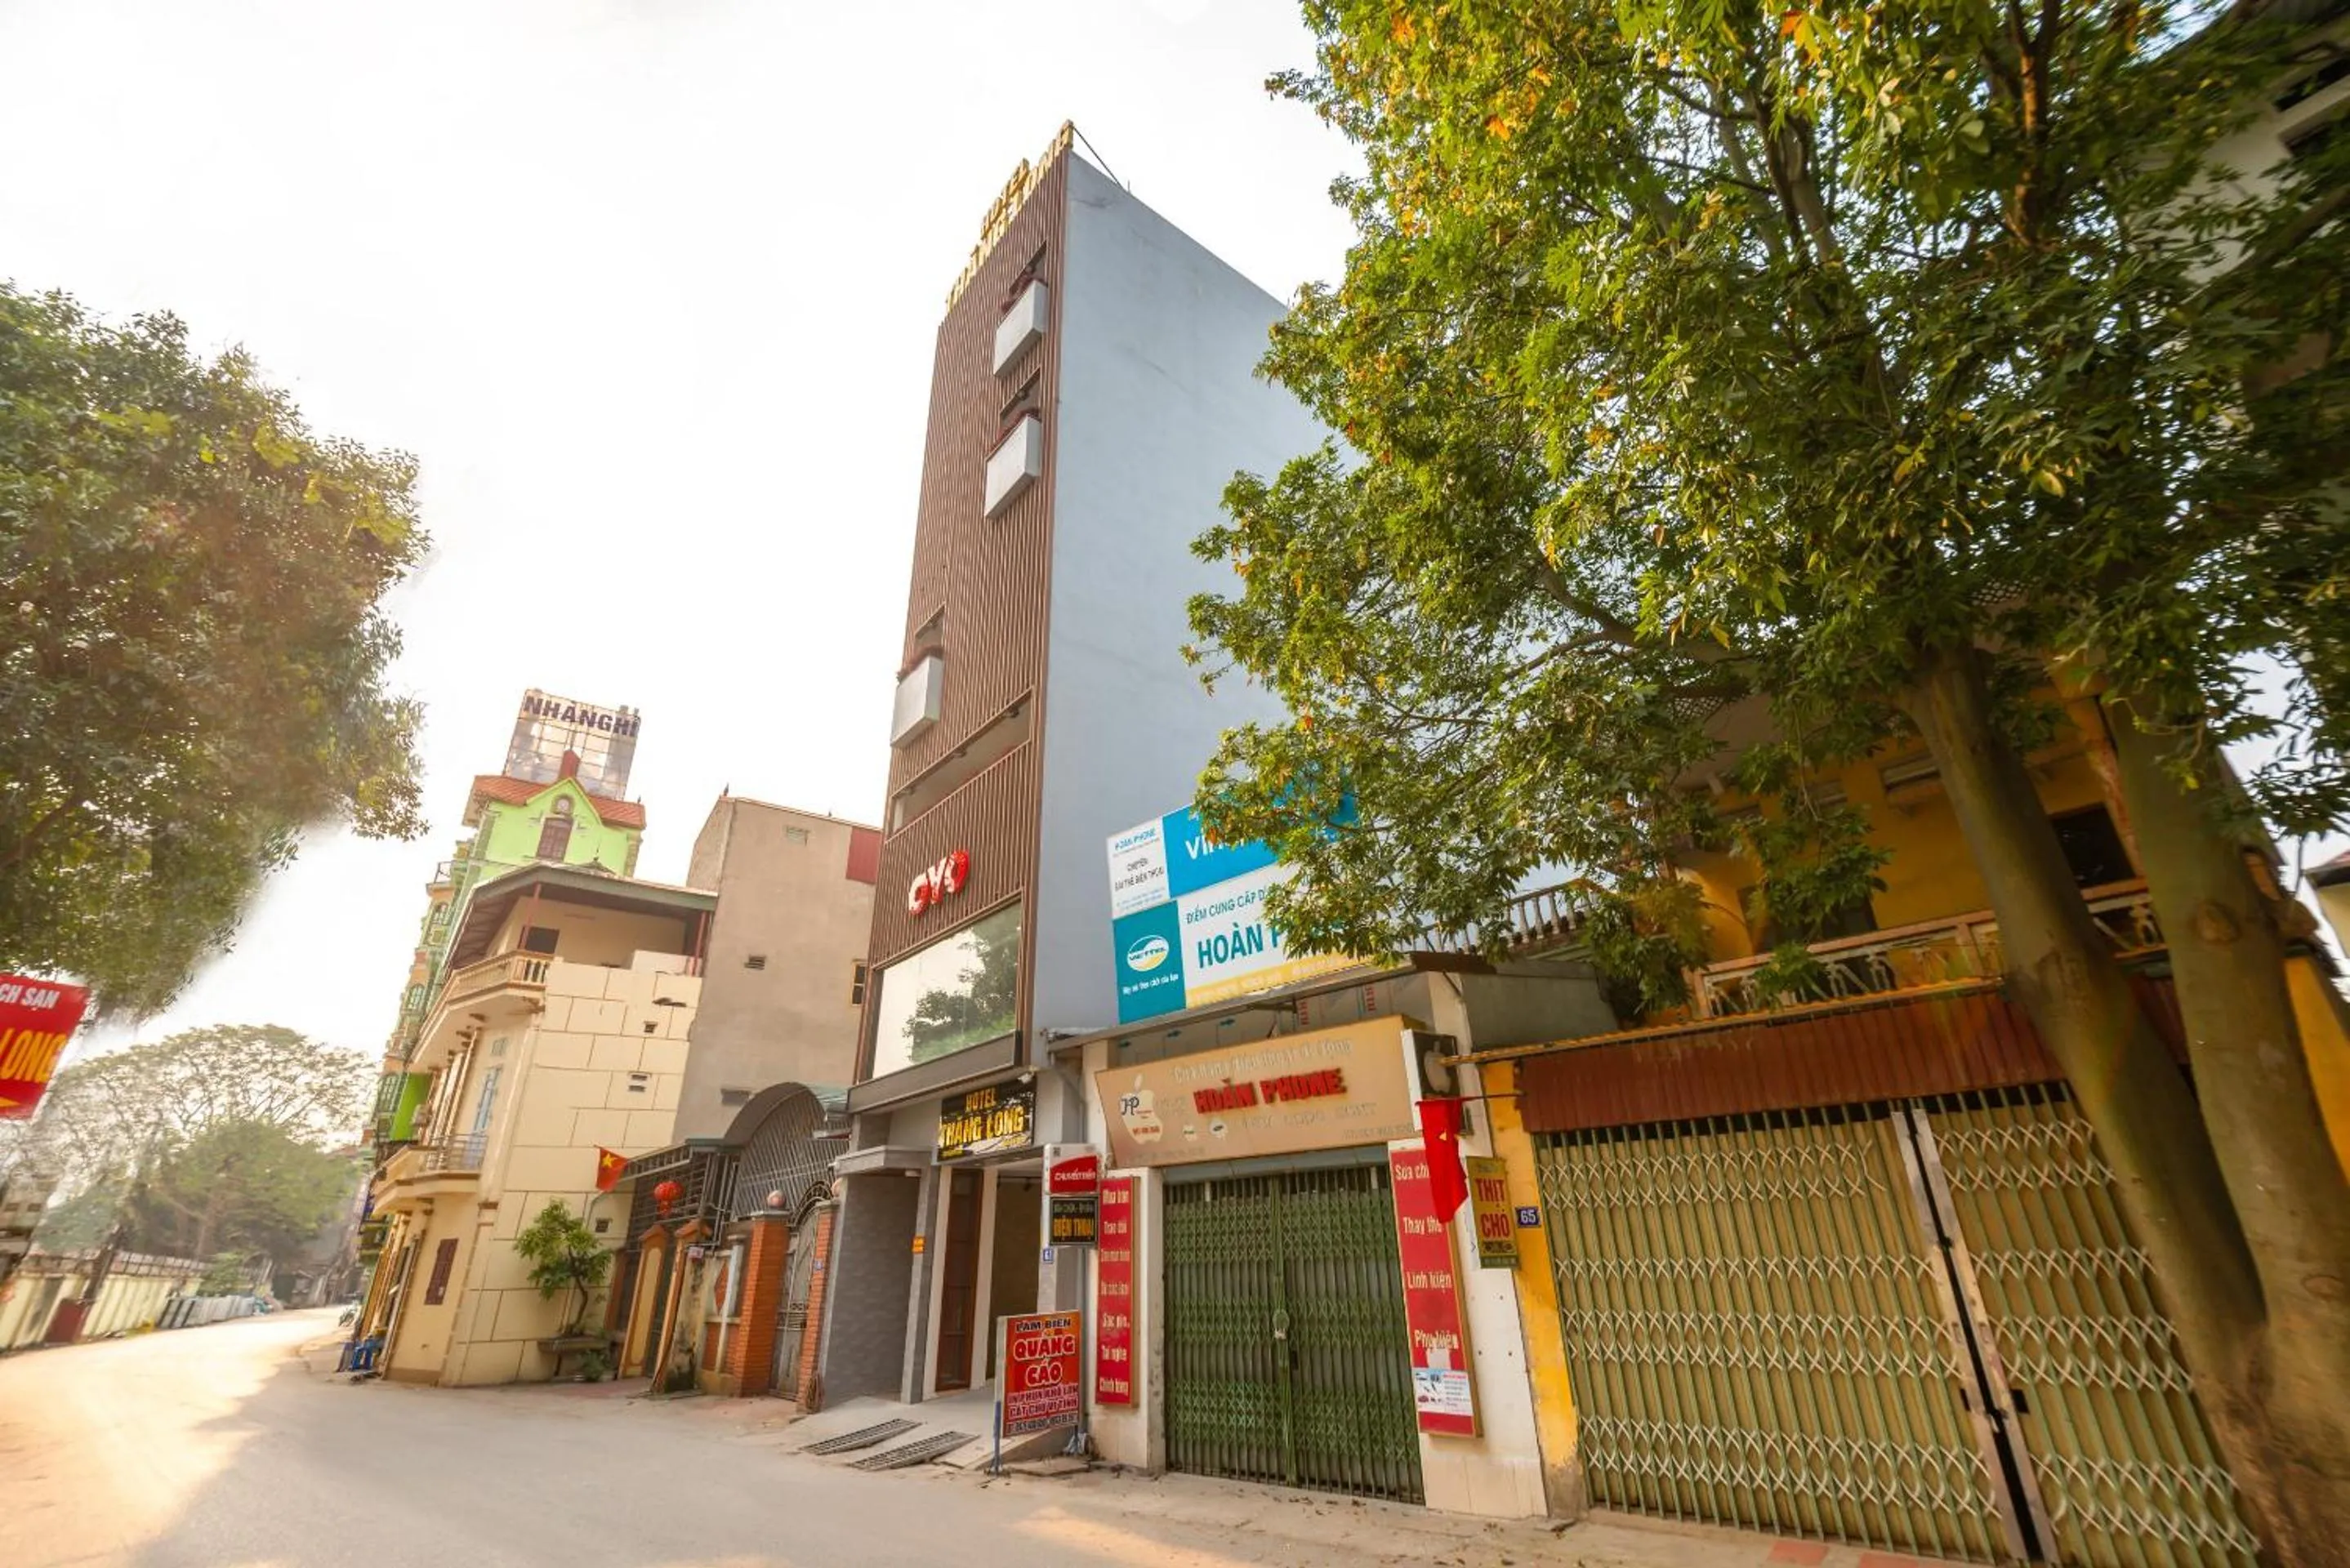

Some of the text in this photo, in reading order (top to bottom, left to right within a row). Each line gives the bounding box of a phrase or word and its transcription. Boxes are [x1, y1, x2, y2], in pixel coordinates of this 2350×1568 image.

[1209, 898, 1235, 918] CUNG
[1198, 921, 1264, 969] HOÀN
[23, 987, 60, 1011] SẠN
[1259, 1067, 1348, 1104] PHONE
[965, 1087, 997, 1111] HOTEL
[985, 1104, 1025, 1140] LONG
[1475, 1178, 1505, 1208] THỊT
[1403, 1216, 1425, 1235] Thay
[1520, 1209, 1536, 1224] 65
[1407, 1271, 1428, 1289] Linh
[1026, 1358, 1063, 1387] CÁO
